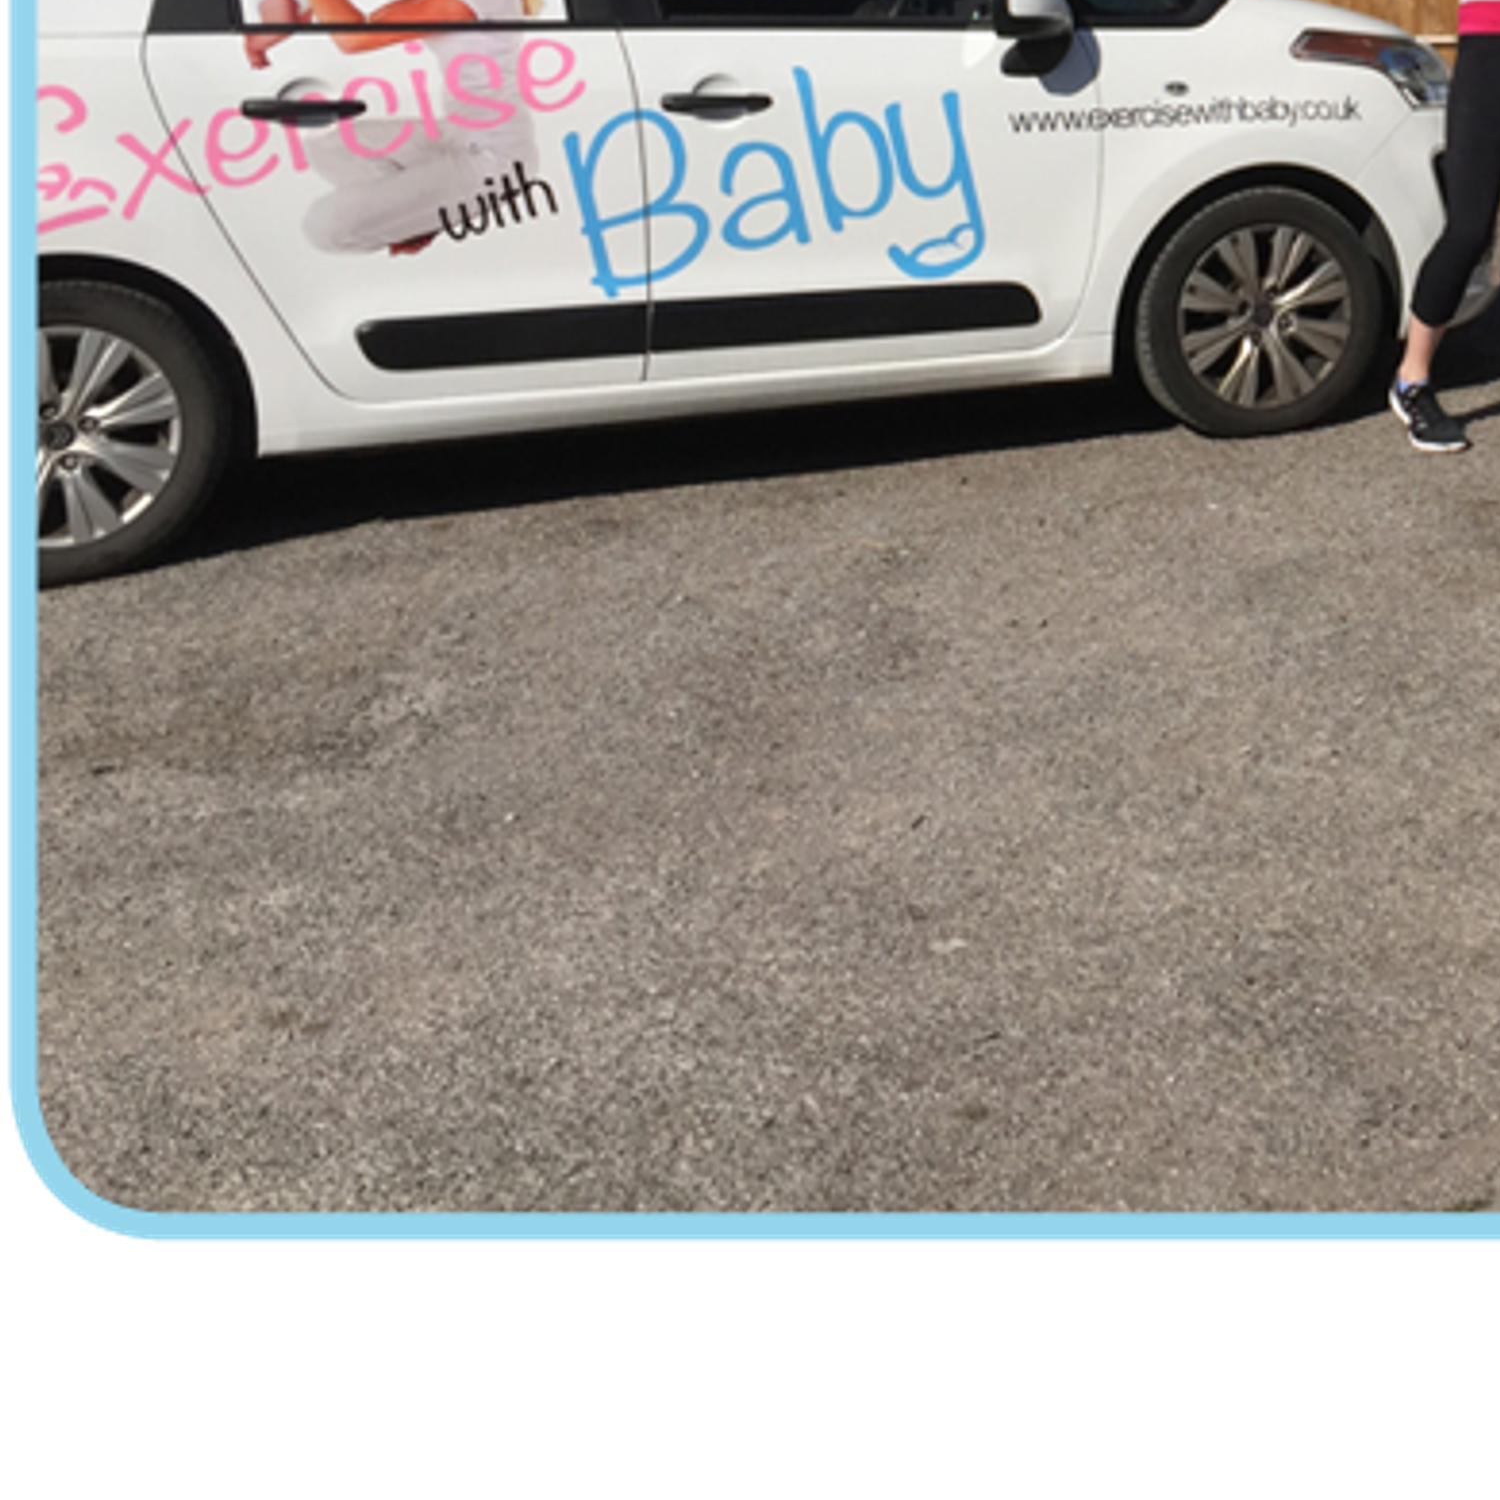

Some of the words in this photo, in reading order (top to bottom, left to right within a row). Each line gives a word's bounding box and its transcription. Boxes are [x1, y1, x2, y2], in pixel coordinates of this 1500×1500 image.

[438, 160, 558, 240] with
[562, 65, 987, 299] Baby
[1008, 95, 1362, 134] www.exercisewithbaby.co.uk
